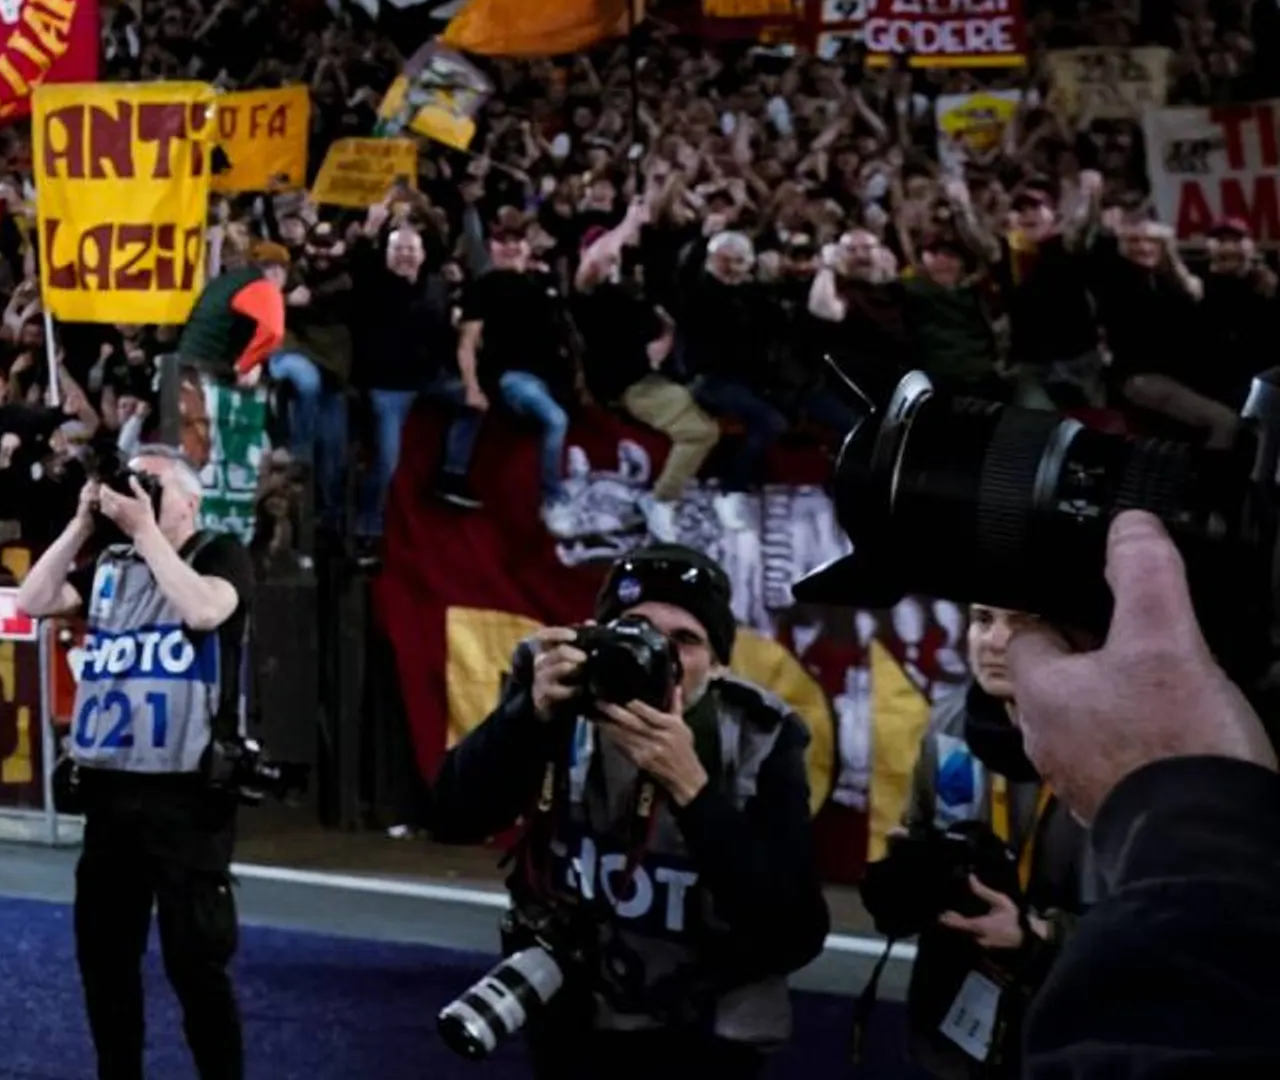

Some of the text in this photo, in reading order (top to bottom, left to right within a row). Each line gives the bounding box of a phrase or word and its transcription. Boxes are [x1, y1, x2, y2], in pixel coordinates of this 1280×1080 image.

[863, 17, 1016, 53] GODERE
[76, 691, 169, 749] 021
[560, 835, 700, 933] HOT
